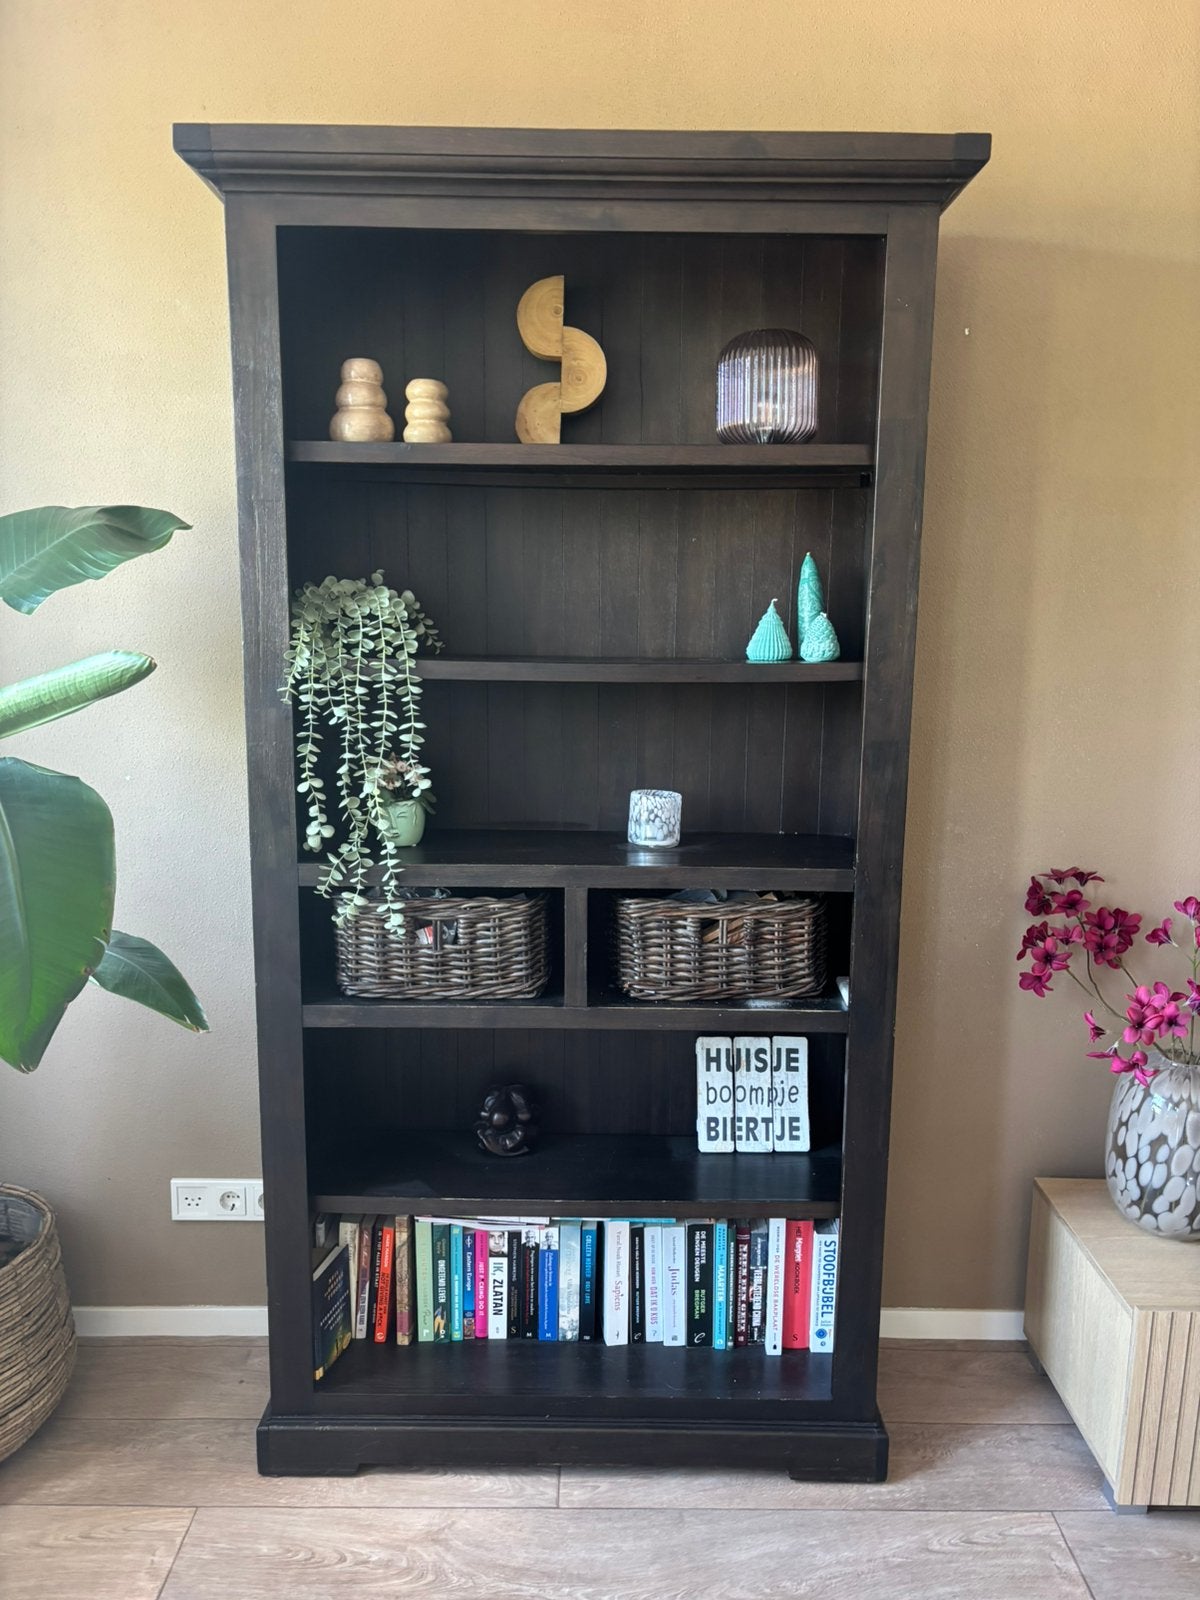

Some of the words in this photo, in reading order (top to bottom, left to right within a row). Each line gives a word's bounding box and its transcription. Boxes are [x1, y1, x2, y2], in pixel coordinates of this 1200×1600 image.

[705, 1048, 800, 1072] HUISJE
[706, 1080, 799, 1107] boompje
[706, 1117, 800, 1141] BIERTJE
[700, 1230, 706, 1240] DE
[774, 1254, 780, 1263] DE
[794, 1237, 803, 1262] Margriet
[438, 1260, 446, 1286] ONGETEMD
[492, 1262, 504, 1276] IK,
[668, 1266, 680, 1296] Judas
[820, 1240, 837, 1318] STOOFBIJBEL
[438, 1287, 446, 1303] LEVEN
[612, 1280, 624, 1310] Sapiens
[650, 1286, 658, 1298] DAT
[718, 1264, 726, 1302] MAARTEN
[478, 1300, 484, 1310] DO
[492, 1279, 504, 1316] ZLATAN
[650, 1312, 658, 1325] KUS
[752, 1310, 762, 1326] CHINA
